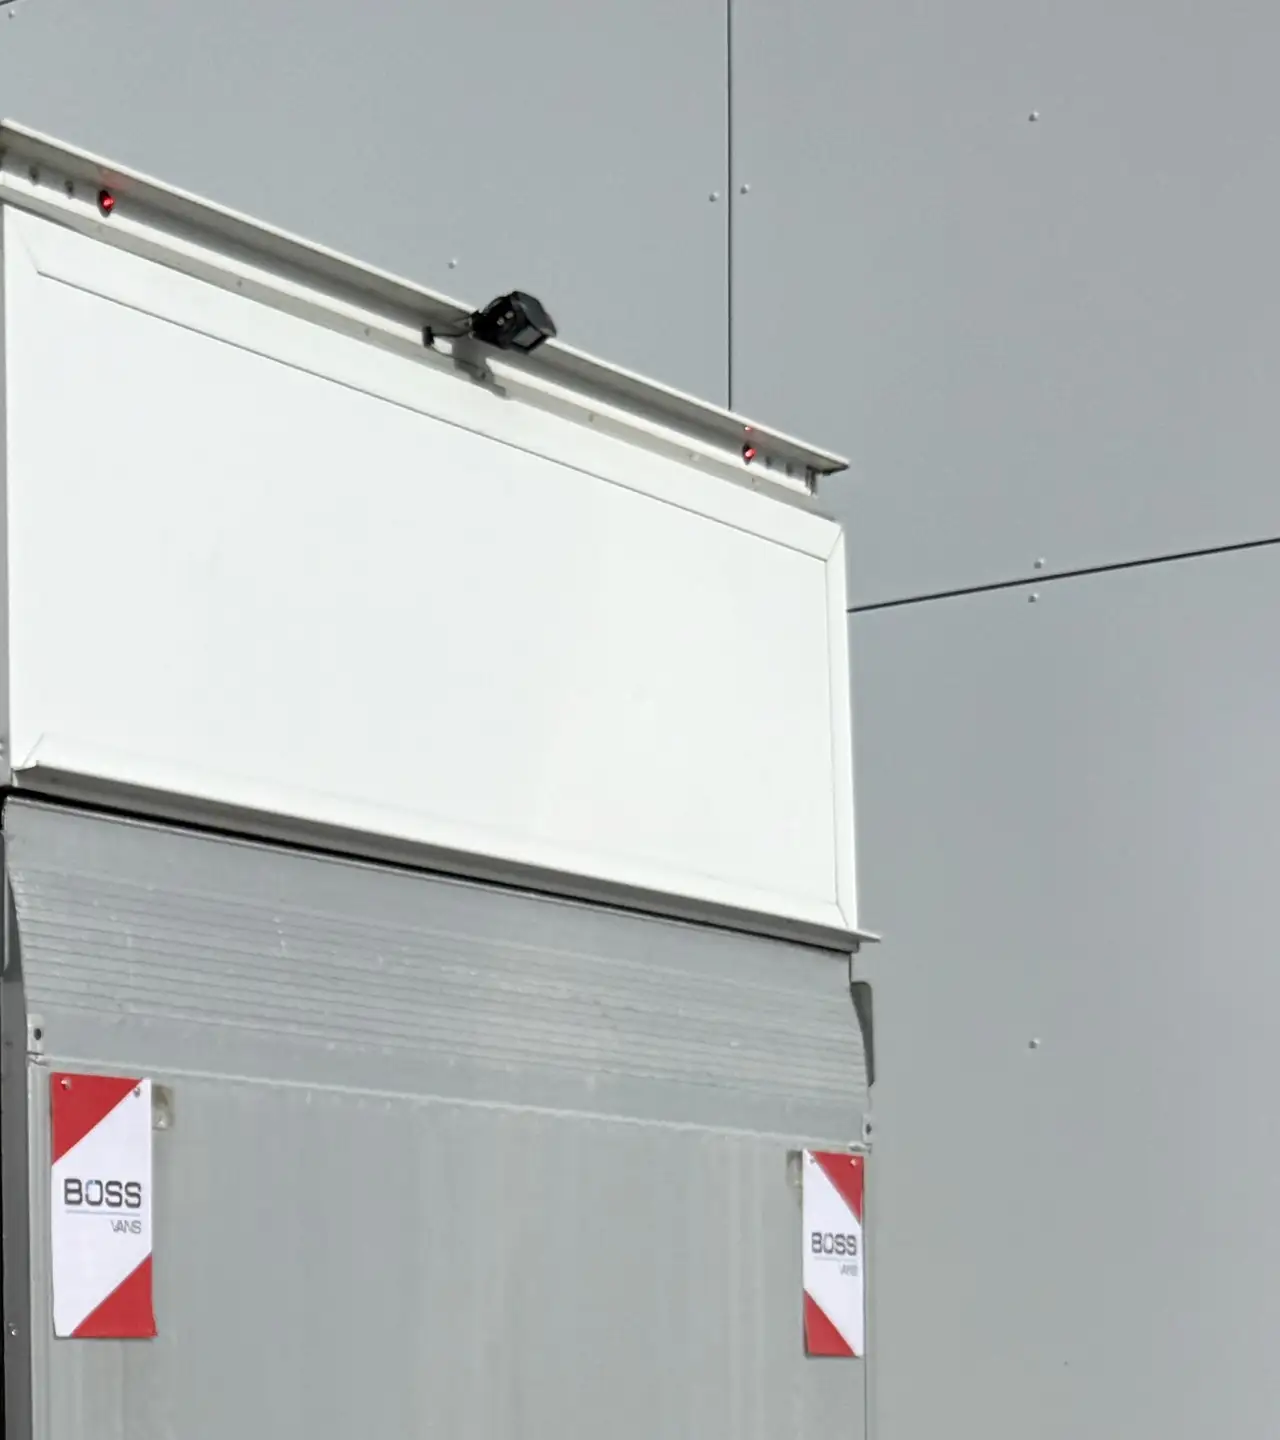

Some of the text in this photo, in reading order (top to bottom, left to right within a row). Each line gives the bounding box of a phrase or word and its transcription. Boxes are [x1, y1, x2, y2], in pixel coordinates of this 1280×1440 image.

[63, 1178, 142, 1208] BOSS
[110, 1220, 142, 1234] VANS
[811, 1231, 857, 1256] BOSS
